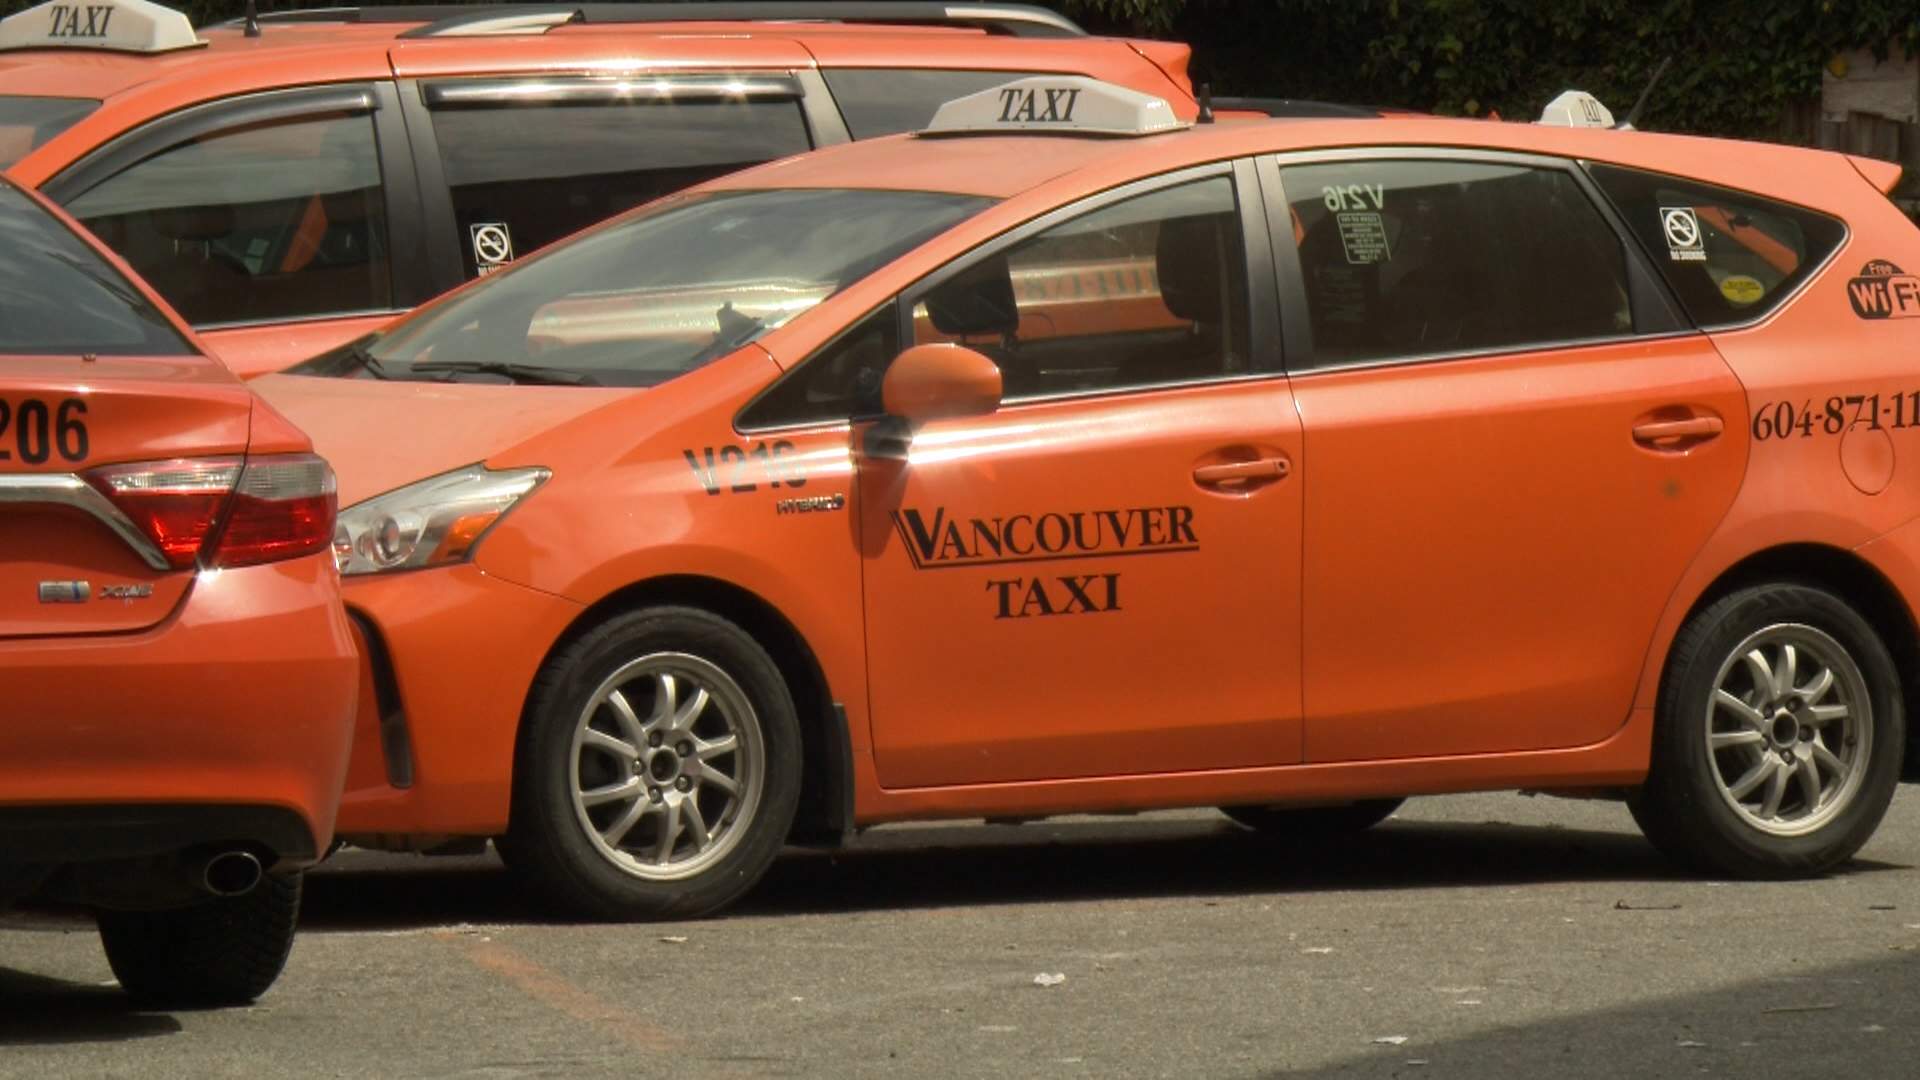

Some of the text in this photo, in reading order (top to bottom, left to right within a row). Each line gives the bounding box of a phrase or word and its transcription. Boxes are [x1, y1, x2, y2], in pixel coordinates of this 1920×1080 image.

[48, 5, 114, 37] TAXI
[997, 88, 1081, 122] TAXI
[1868, 262, 1892, 275] Free
[900, 505, 1199, 561] VANCOUVER
[986, 573, 1123, 620] TAXI
